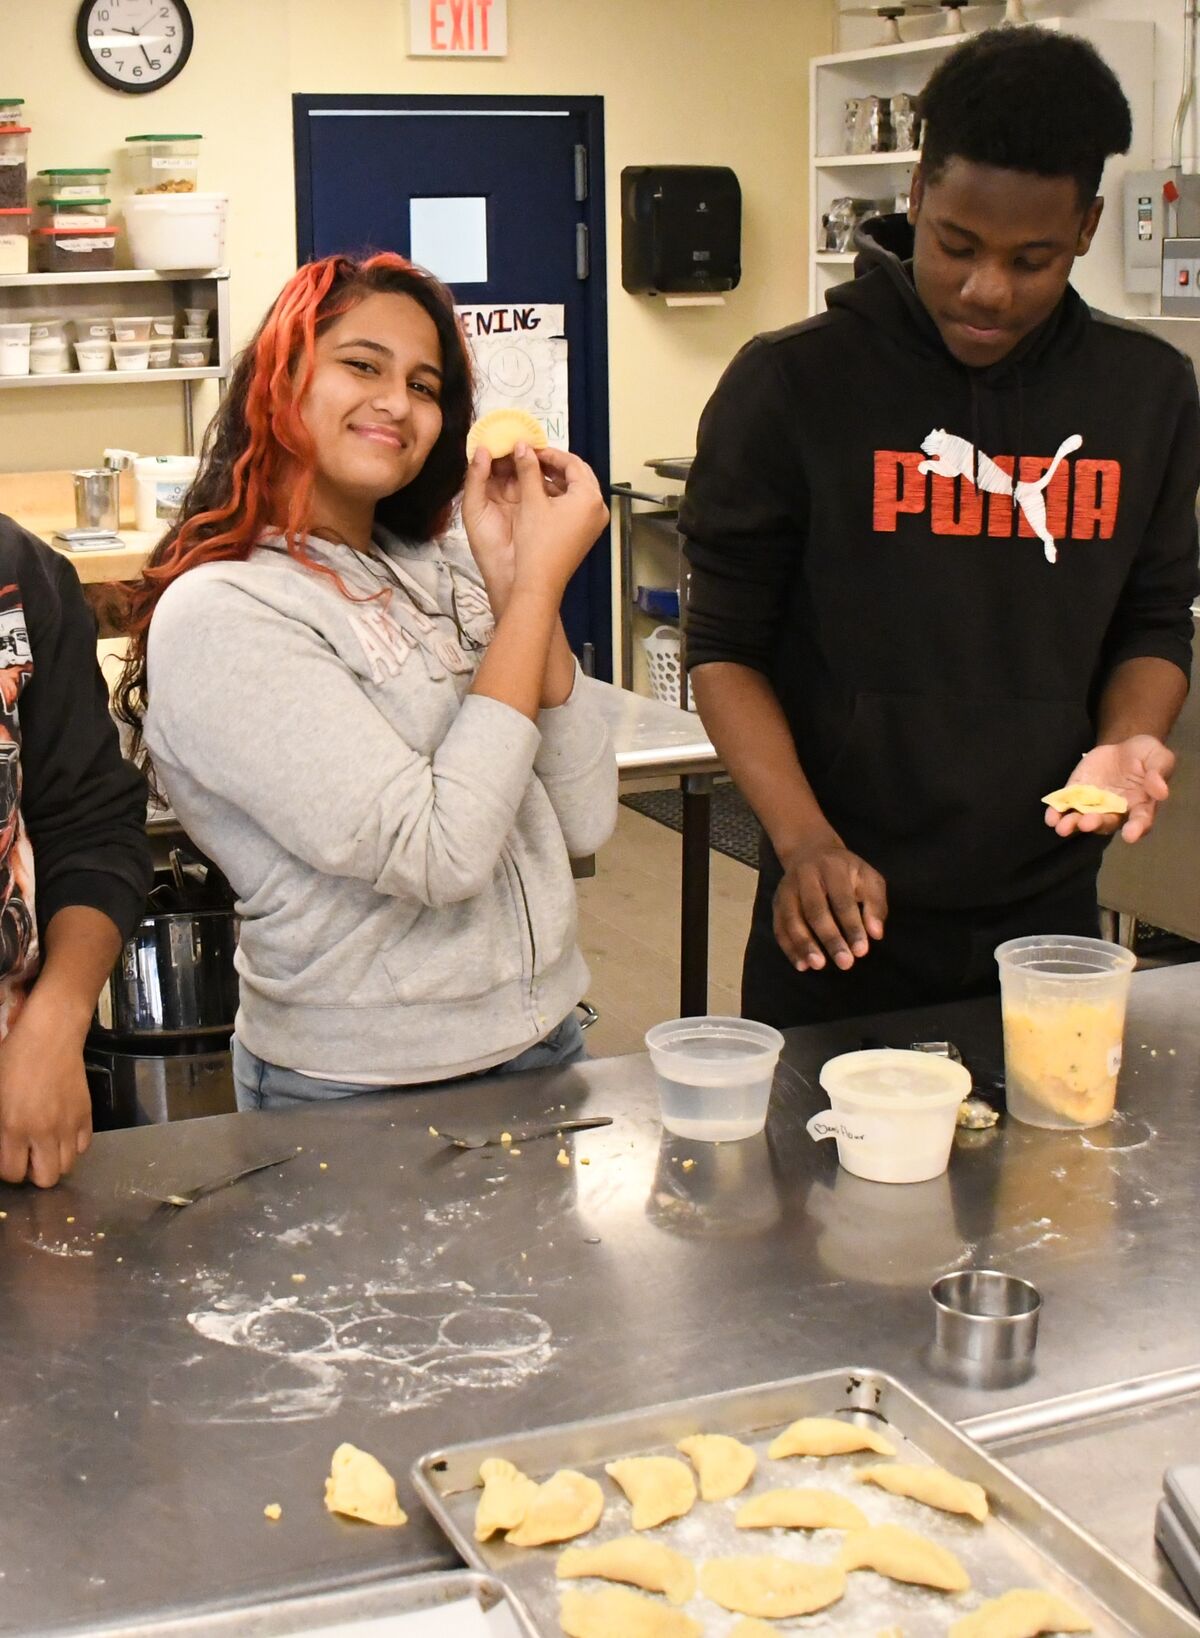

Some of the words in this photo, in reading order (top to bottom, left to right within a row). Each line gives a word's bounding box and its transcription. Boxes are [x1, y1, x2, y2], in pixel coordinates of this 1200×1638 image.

[98, 9, 110, 21] 10
[160, 7, 169, 18] 2
[430, 0, 494, 51] EXIT
[165, 26, 176, 37] 3
[101, 48, 112, 58] 8
[163, 44, 172, 54] 4
[115, 61, 124, 72] 7
[151, 60, 161, 70] 5
[132, 66, 143, 77] 6
[873, 450, 1121, 540] PUMA
